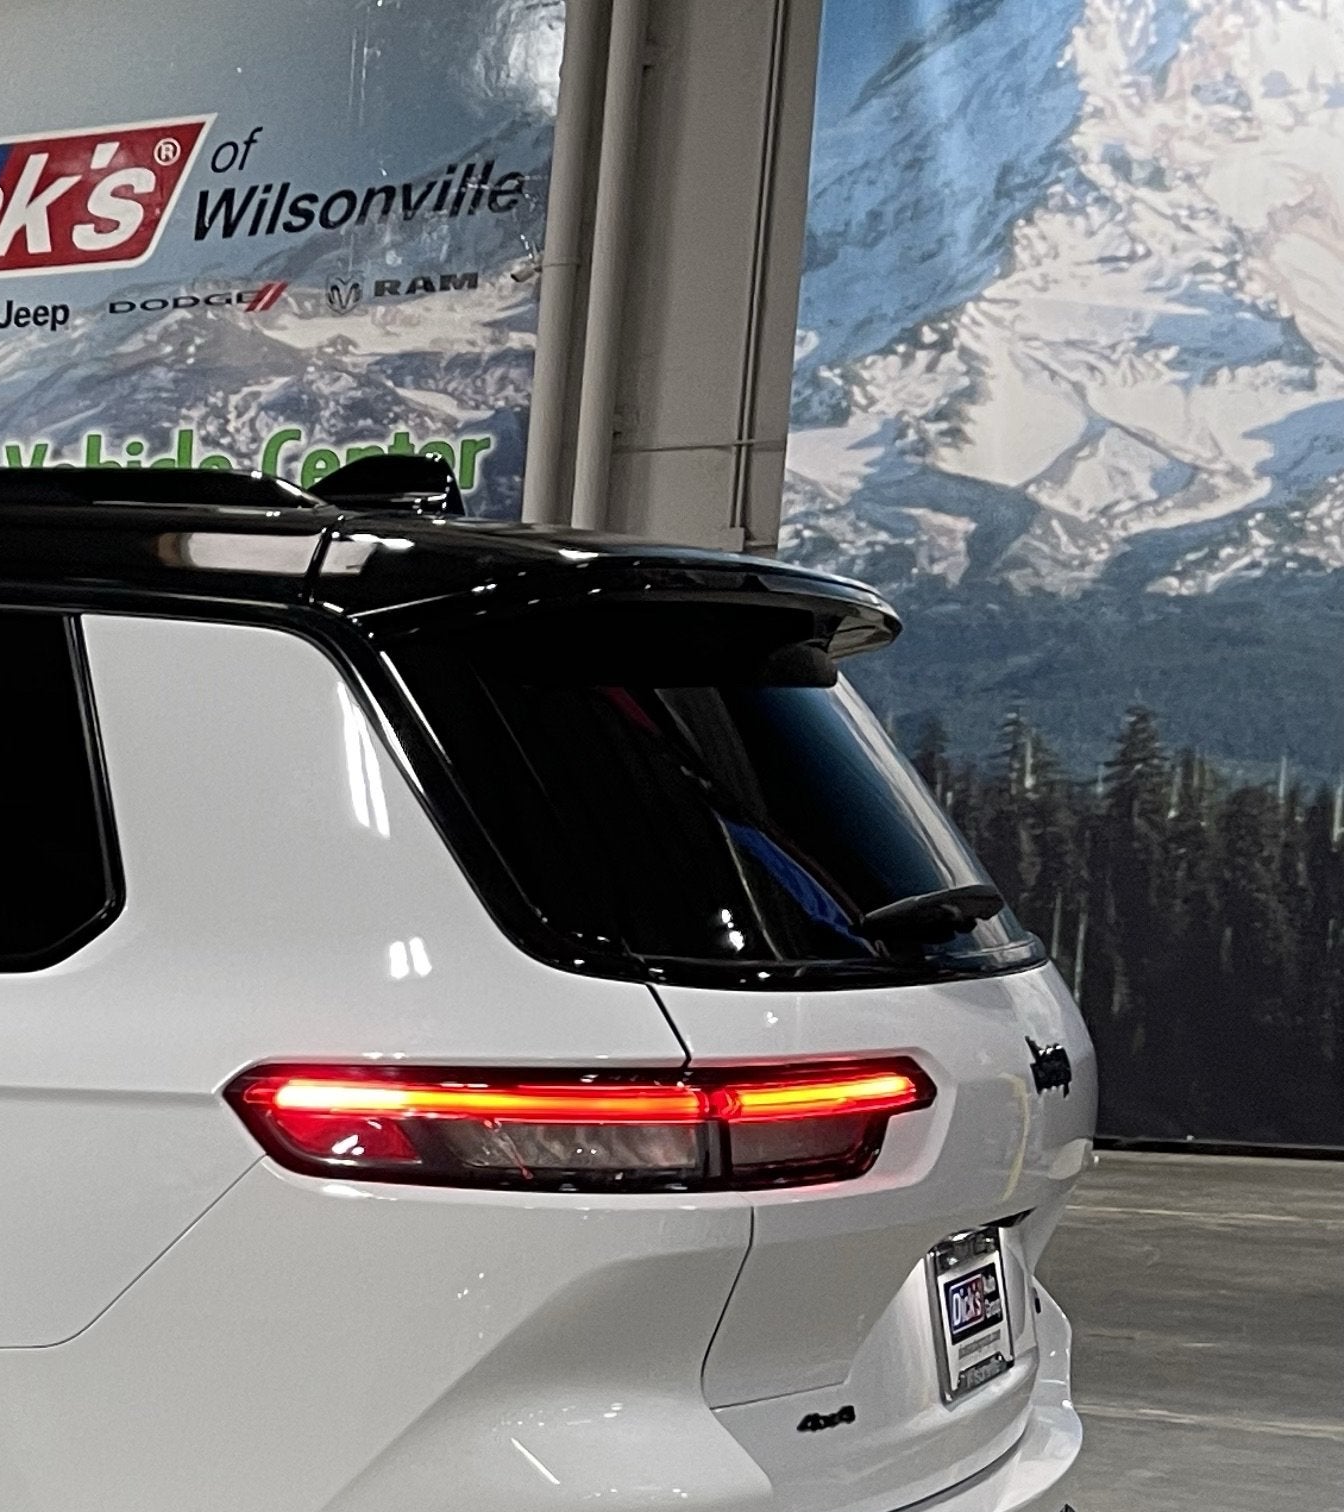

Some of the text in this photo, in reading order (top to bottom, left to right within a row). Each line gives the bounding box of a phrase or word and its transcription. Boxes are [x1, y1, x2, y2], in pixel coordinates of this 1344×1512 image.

[210, 127, 263, 173] of
[194, 159, 526, 241] Wilsonville
[108, 288, 261, 315] DODGE
[374, 272, 479, 298] RAM
[262, 428, 491, 490] Cer
